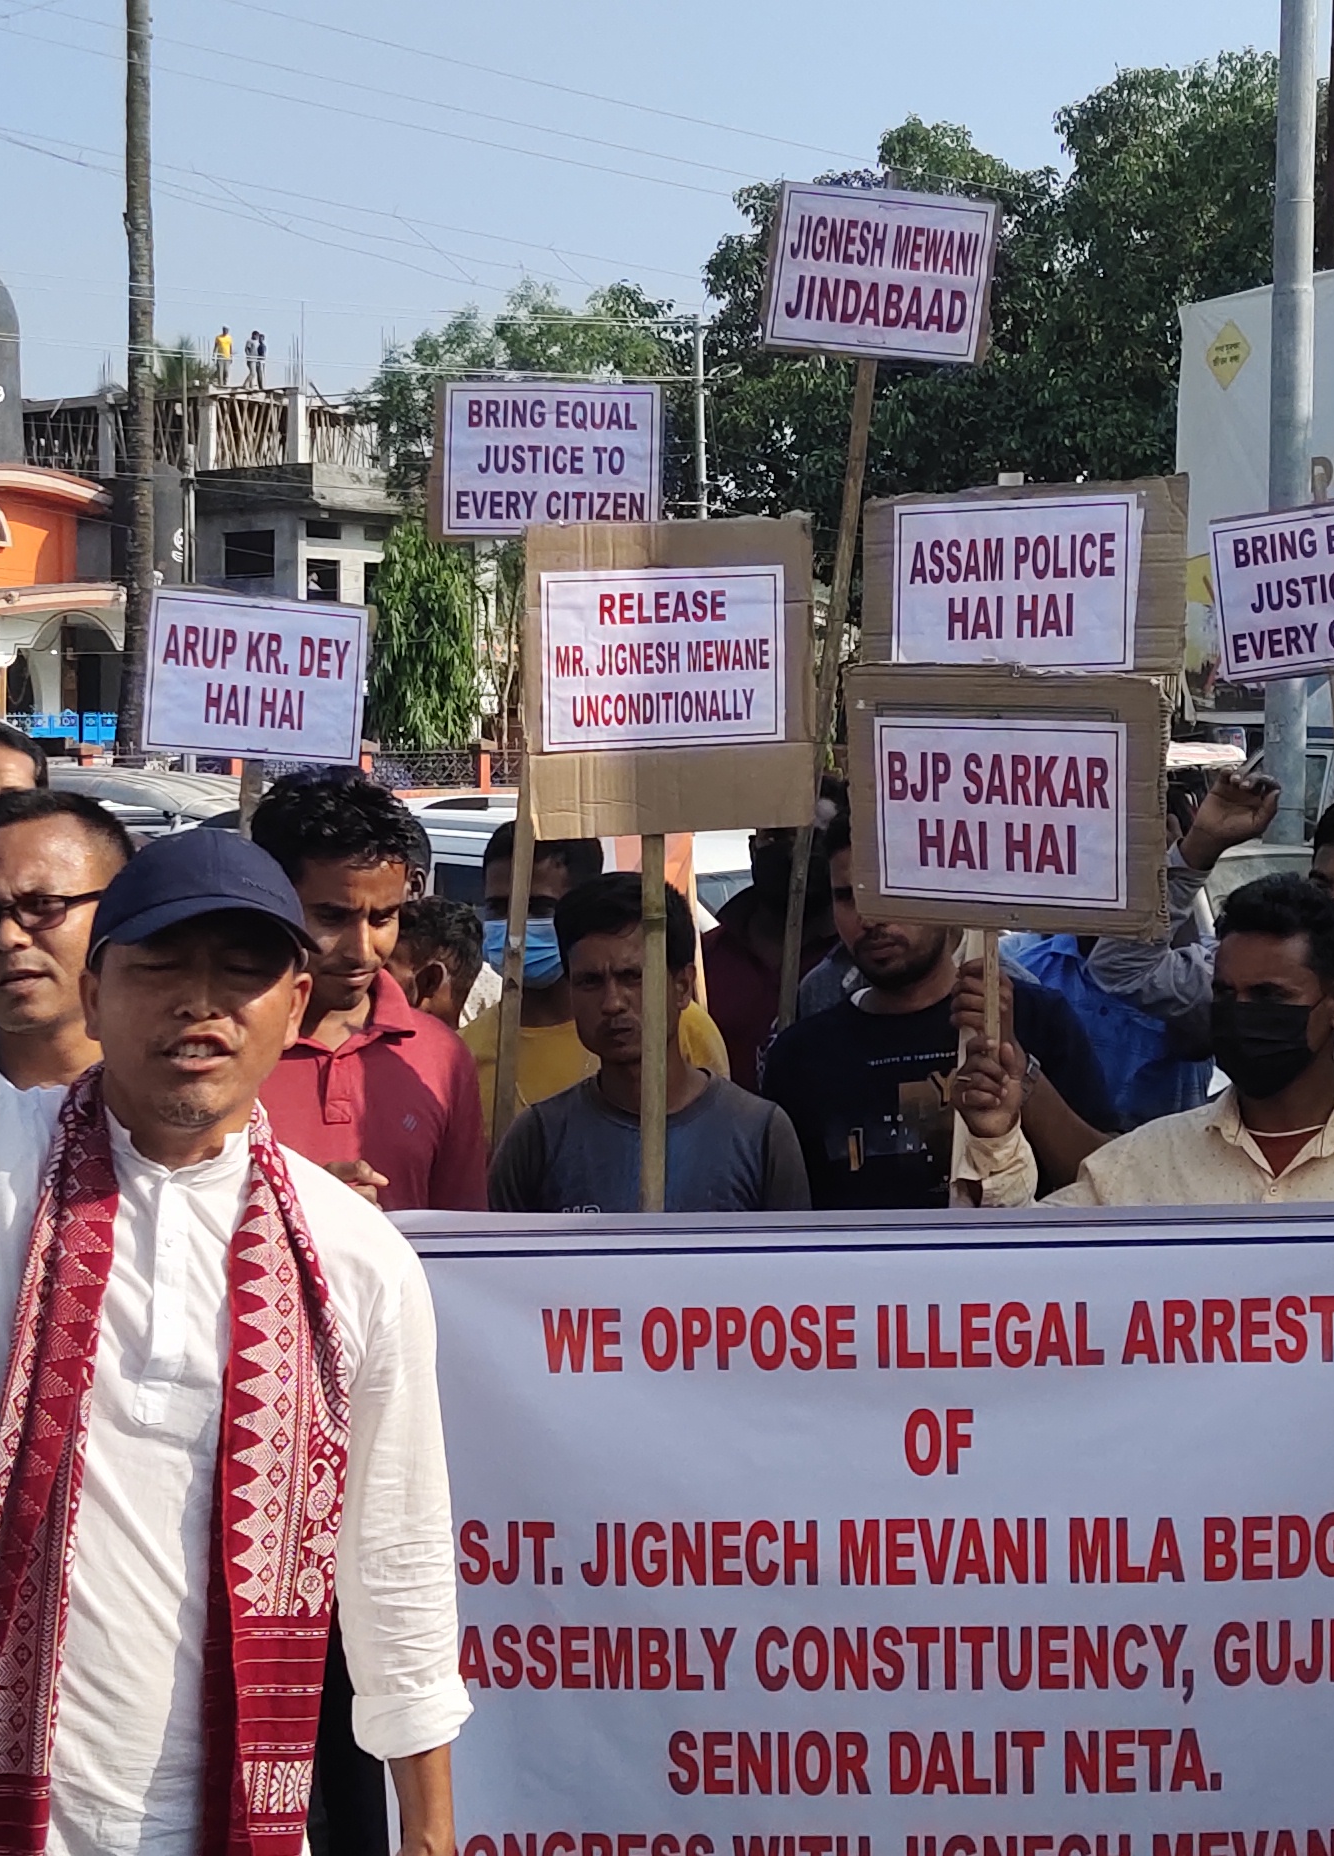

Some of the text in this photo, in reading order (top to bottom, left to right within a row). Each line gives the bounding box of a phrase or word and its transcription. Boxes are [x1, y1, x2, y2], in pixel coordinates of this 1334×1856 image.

[791, 215, 979, 276] JIGNESH MEWANI
[785, 275, 966, 333] JINDABAAD
[468, 400, 637, 431] BRING EQUAL
[478, 445, 624, 475] JUSTICE TO
[457, 491, 648, 523] EVERY CITIZEN
[910, 533, 1115, 584] ASSAM POLICE
[1233, 528, 1317, 568] BRING
[600, 590, 726, 625] RELEASE
[948, 593, 1073, 640] HAI HAI
[163, 624, 350, 679] ARUP KR. DEY
[556, 639, 769, 677] MR. JIGNESH MEWANE
[1233, 623, 1318, 663] EVERY
[205, 683, 304, 730] HAI HAI
[573, 689, 754, 727] UNCONDITIONALLY
[888, 751, 1109, 809] BJP SARKAR
[919, 819, 1076, 875] HAI HAI
[542, 1308, 622, 1373] WE
[642, 1305, 856, 1372] OPPOSE
[878, 1302, 1104, 1368] ILLEGAL
[905, 1409, 973, 1476] OF
[459, 1520, 563, 1585] SJT.
[581, 1520, 818, 1587] JIGNECH
[840, 1518, 1047, 1585] MEVANI
[1070, 1518, 1185, 1583] MLA
[459, 1624, 737, 1690] ASSEMBLY
[756, 1624, 1193, 1704] CONSTITUENCY,
[668, 1728, 1221, 1795] SENIOR DALIT NETA.
